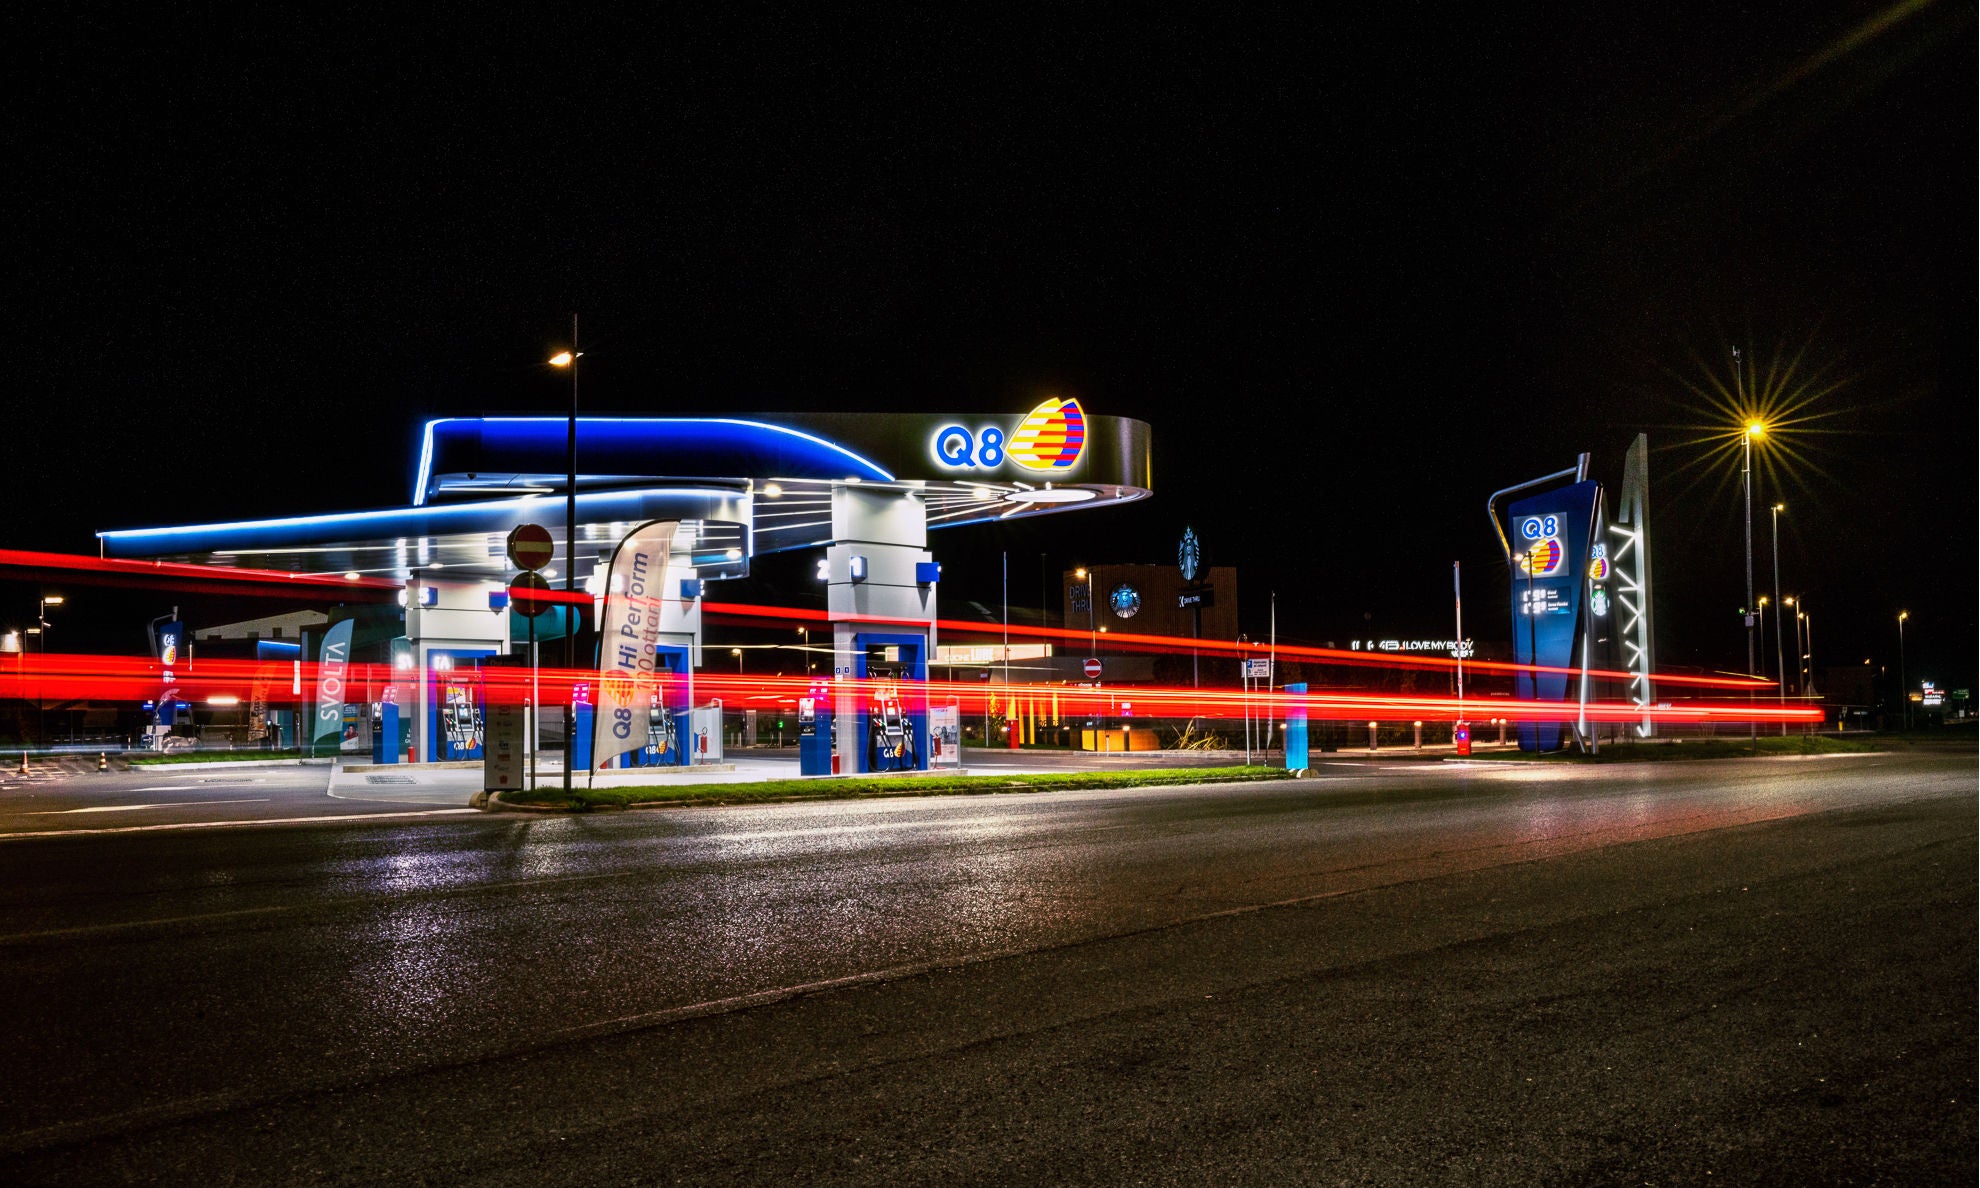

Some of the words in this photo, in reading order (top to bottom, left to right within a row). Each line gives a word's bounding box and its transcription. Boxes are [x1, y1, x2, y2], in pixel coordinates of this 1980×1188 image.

[935, 425, 1005, 468] Q8
[1522, 516, 1557, 539] Q8
[850, 556, 863, 577] 1
[621, 552, 649, 639] Perform
[643, 595, 661, 656] ottani
[618, 645, 639, 669] Hi
[1406, 640, 1431, 651] LOVE
[1431, 640, 1447, 651] MY
[1447, 640, 1474, 651] BODY
[319, 641, 346, 721] SVOLTA
[636, 658, 655, 690] 100
[613, 708, 632, 740] Q8
